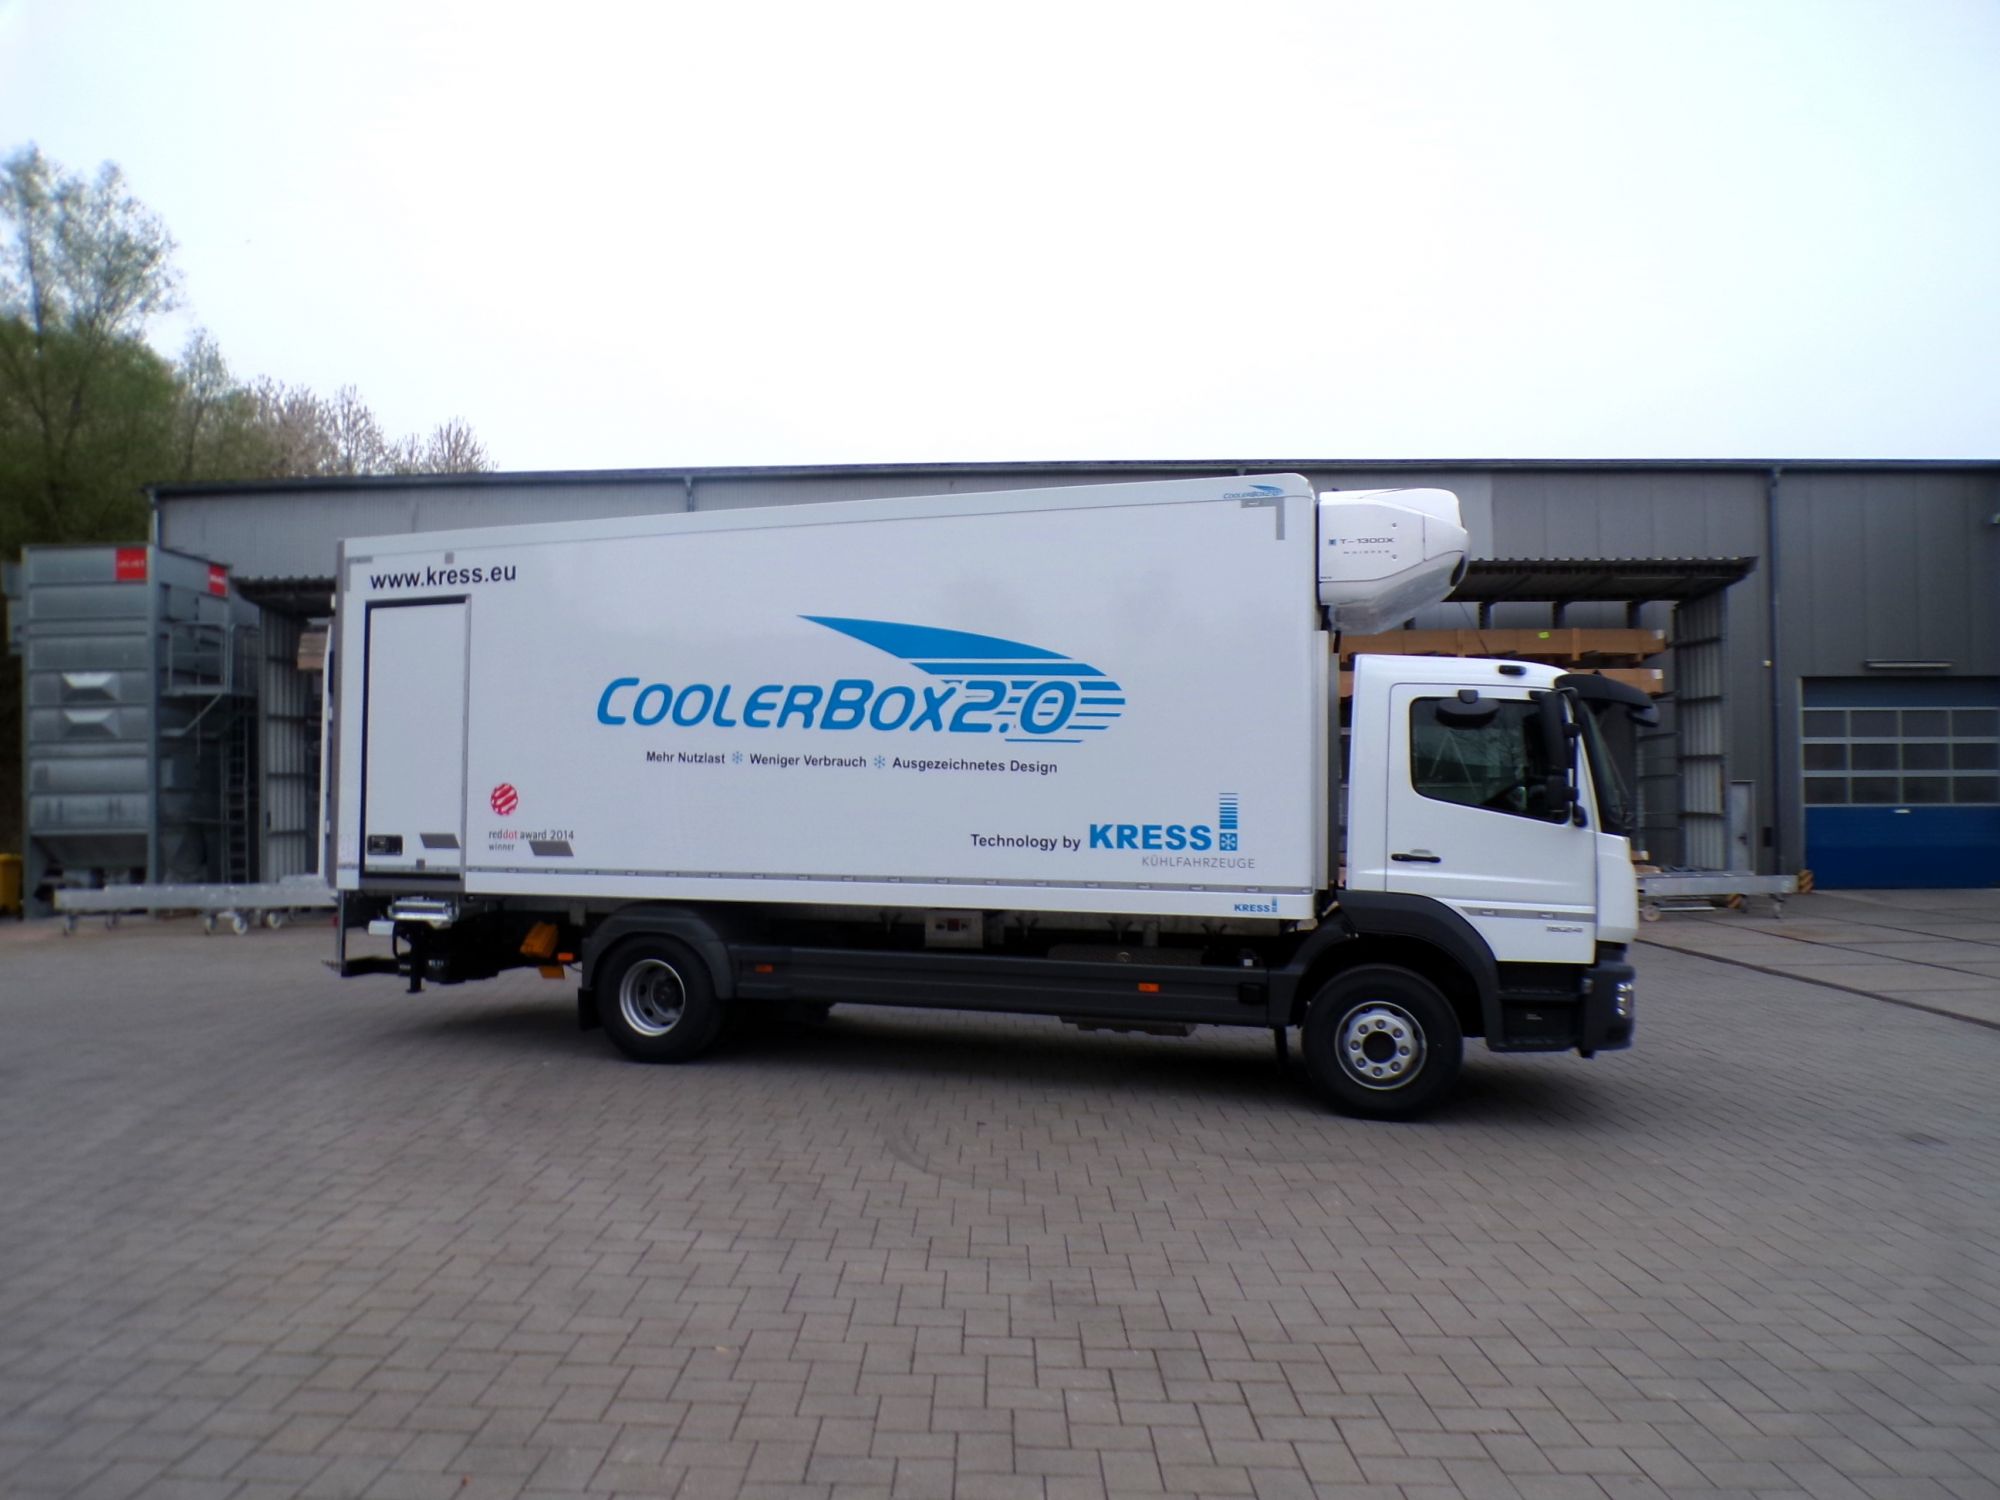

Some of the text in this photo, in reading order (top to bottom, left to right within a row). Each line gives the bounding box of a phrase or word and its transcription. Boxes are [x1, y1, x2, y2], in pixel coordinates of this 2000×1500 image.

[370, 565, 516, 590] www.kress.eu
[646, 751, 725, 764] Mehr Nutzlast
[750, 753, 867, 768] Weniger Verbrauch
[892, 757, 1058, 776] Ausgezeichnetes Design
[519, 829, 548, 840] award
[549, 829, 575, 840] 2014
[970, 823, 1212, 852] Technology by KRESS
[488, 843, 515, 851] winner
[1141, 855, 1256, 869] KÜHLFAHRZEUGE
[1234, 903, 1271, 913] KRESS
